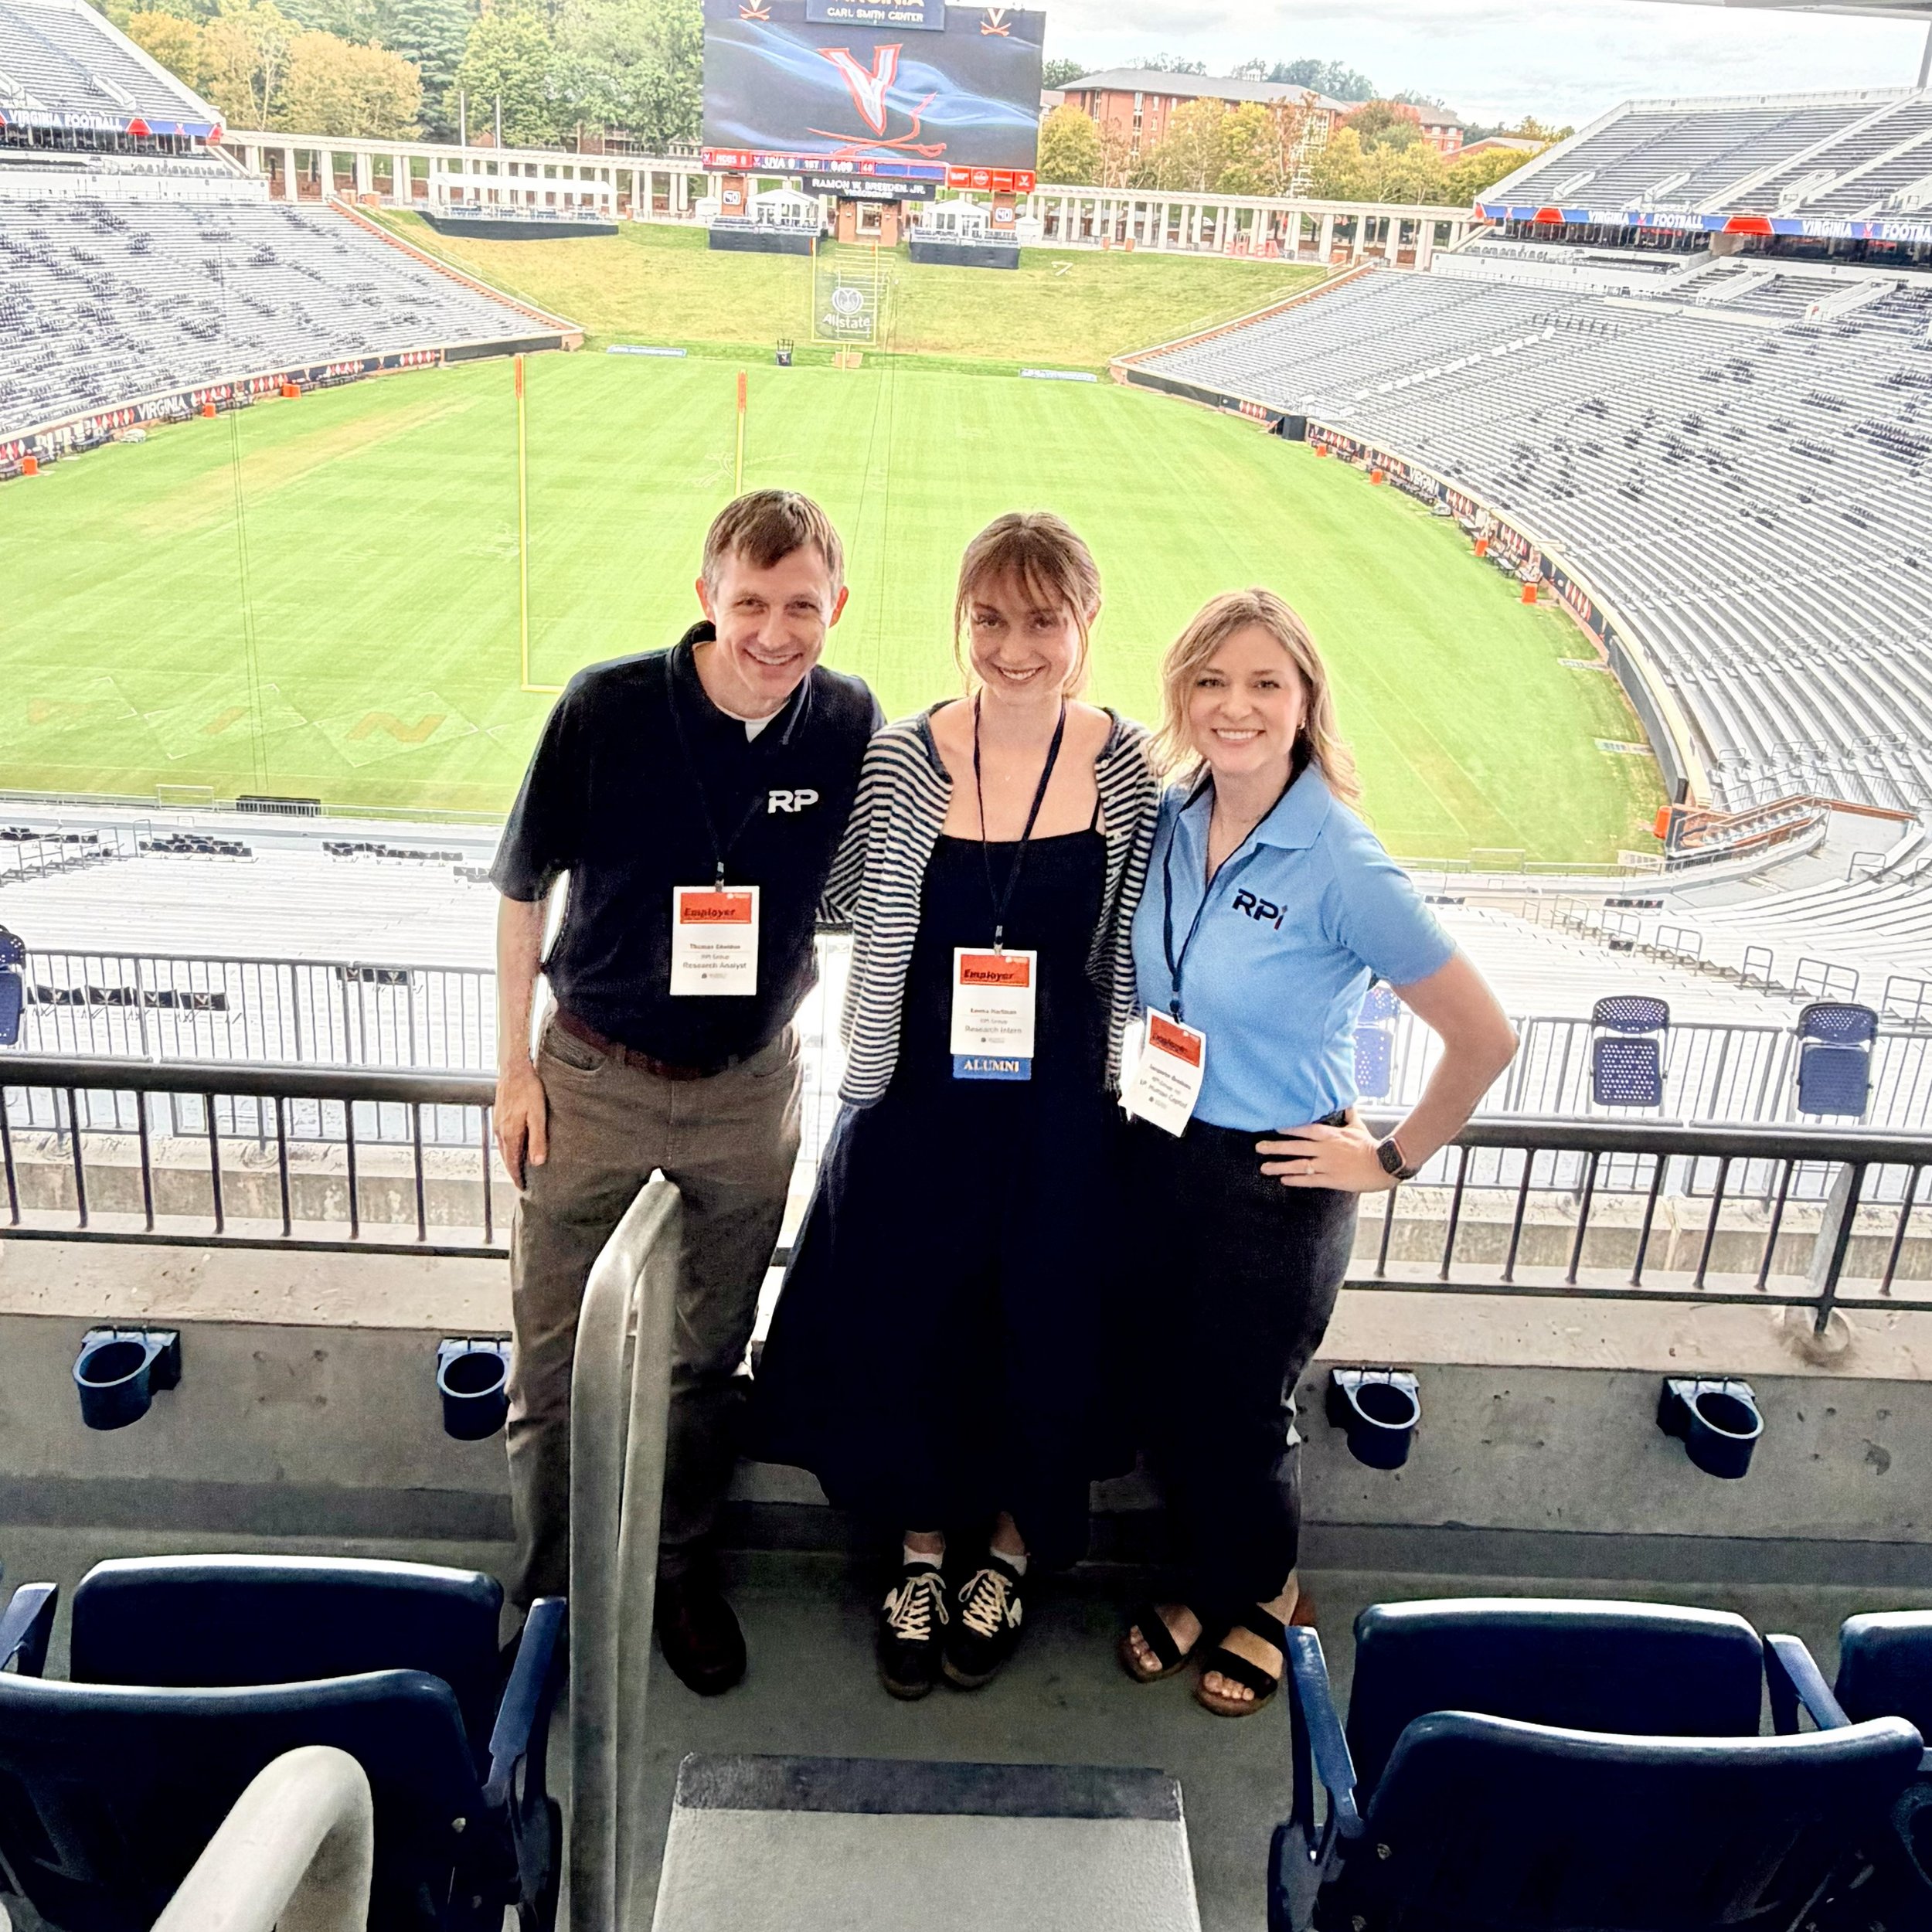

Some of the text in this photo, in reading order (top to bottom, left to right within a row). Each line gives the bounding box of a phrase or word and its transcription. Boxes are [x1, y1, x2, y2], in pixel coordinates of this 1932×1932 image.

[827, 7, 924, 22] CARL SMITH CENTER
[9, 110, 123, 131] VIRGINIA FOOTBALL
[811, 178, 850, 189] RAMON
[1588, 211, 1630, 226] VIRGINIA
[1652, 214, 1704, 230] FOOTBALL
[1802, 220, 1852, 237] VIRGINIA
[821, 313, 870, 328] Allstate
[137, 395, 189, 420] VIRGINIA
[767, 788, 819, 814] RP
[684, 907, 736, 918] Employer
[719, 962, 747, 971] Analyst
[964, 968, 1015, 982] Employer
[964, 1060, 1019, 1073] ALUMNI
